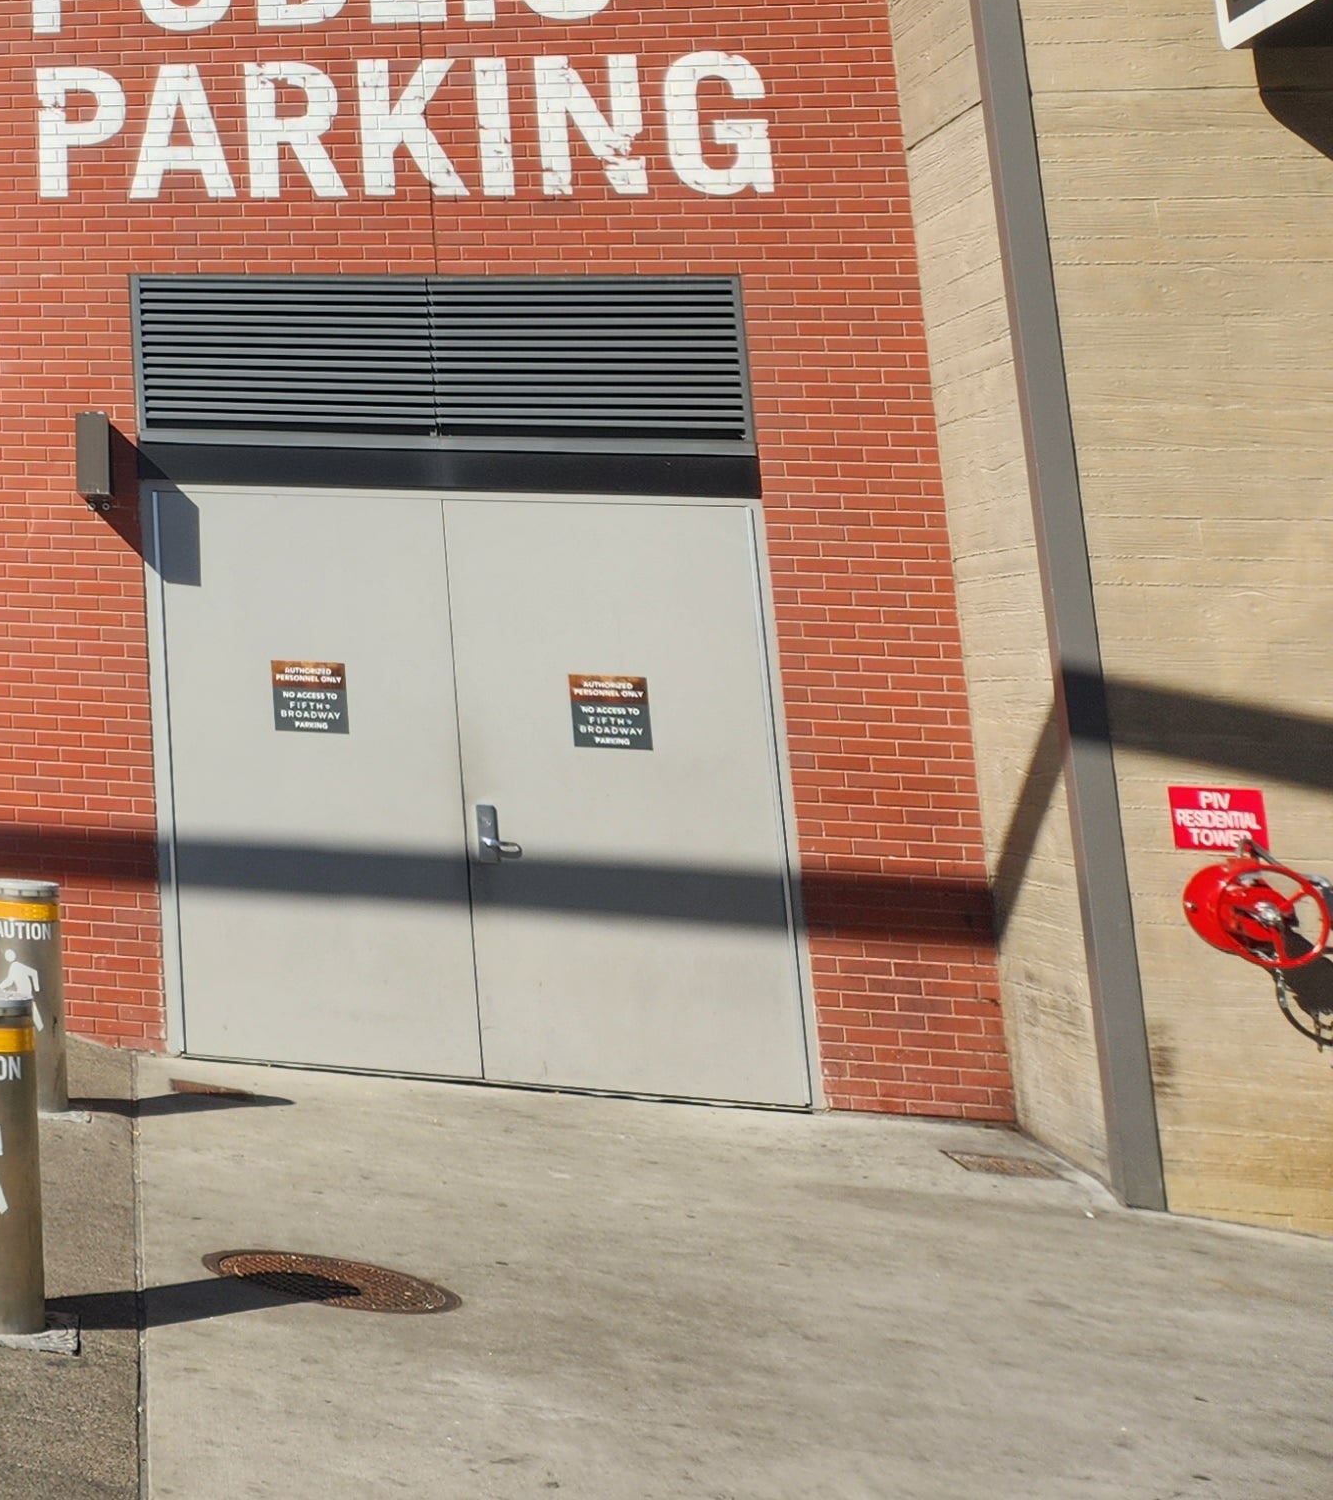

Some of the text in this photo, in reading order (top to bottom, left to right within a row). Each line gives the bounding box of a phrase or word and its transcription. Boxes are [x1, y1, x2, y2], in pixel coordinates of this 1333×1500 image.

[35, 50, 775, 198] PARKING
[285, 667, 332, 676] AUTHORIZED
[276, 673, 342, 684] PERSONNEL ONLY
[582, 681, 634, 690] AUTHORIZED
[282, 691, 338, 700] NO ACCESS TO
[573, 688, 644, 698] PERSONNEL ONLY
[280, 709, 341, 720] BROADWAY
[580, 705, 640, 716] NO ACCESS TO
[294, 720, 329, 730] PARKING
[578, 724, 644, 736] BROADWAY
[594, 736, 631, 746] PARKING
[1198, 790, 1231, 810] PIV
[1174, 808, 1262, 830] RESIDENTIAL
